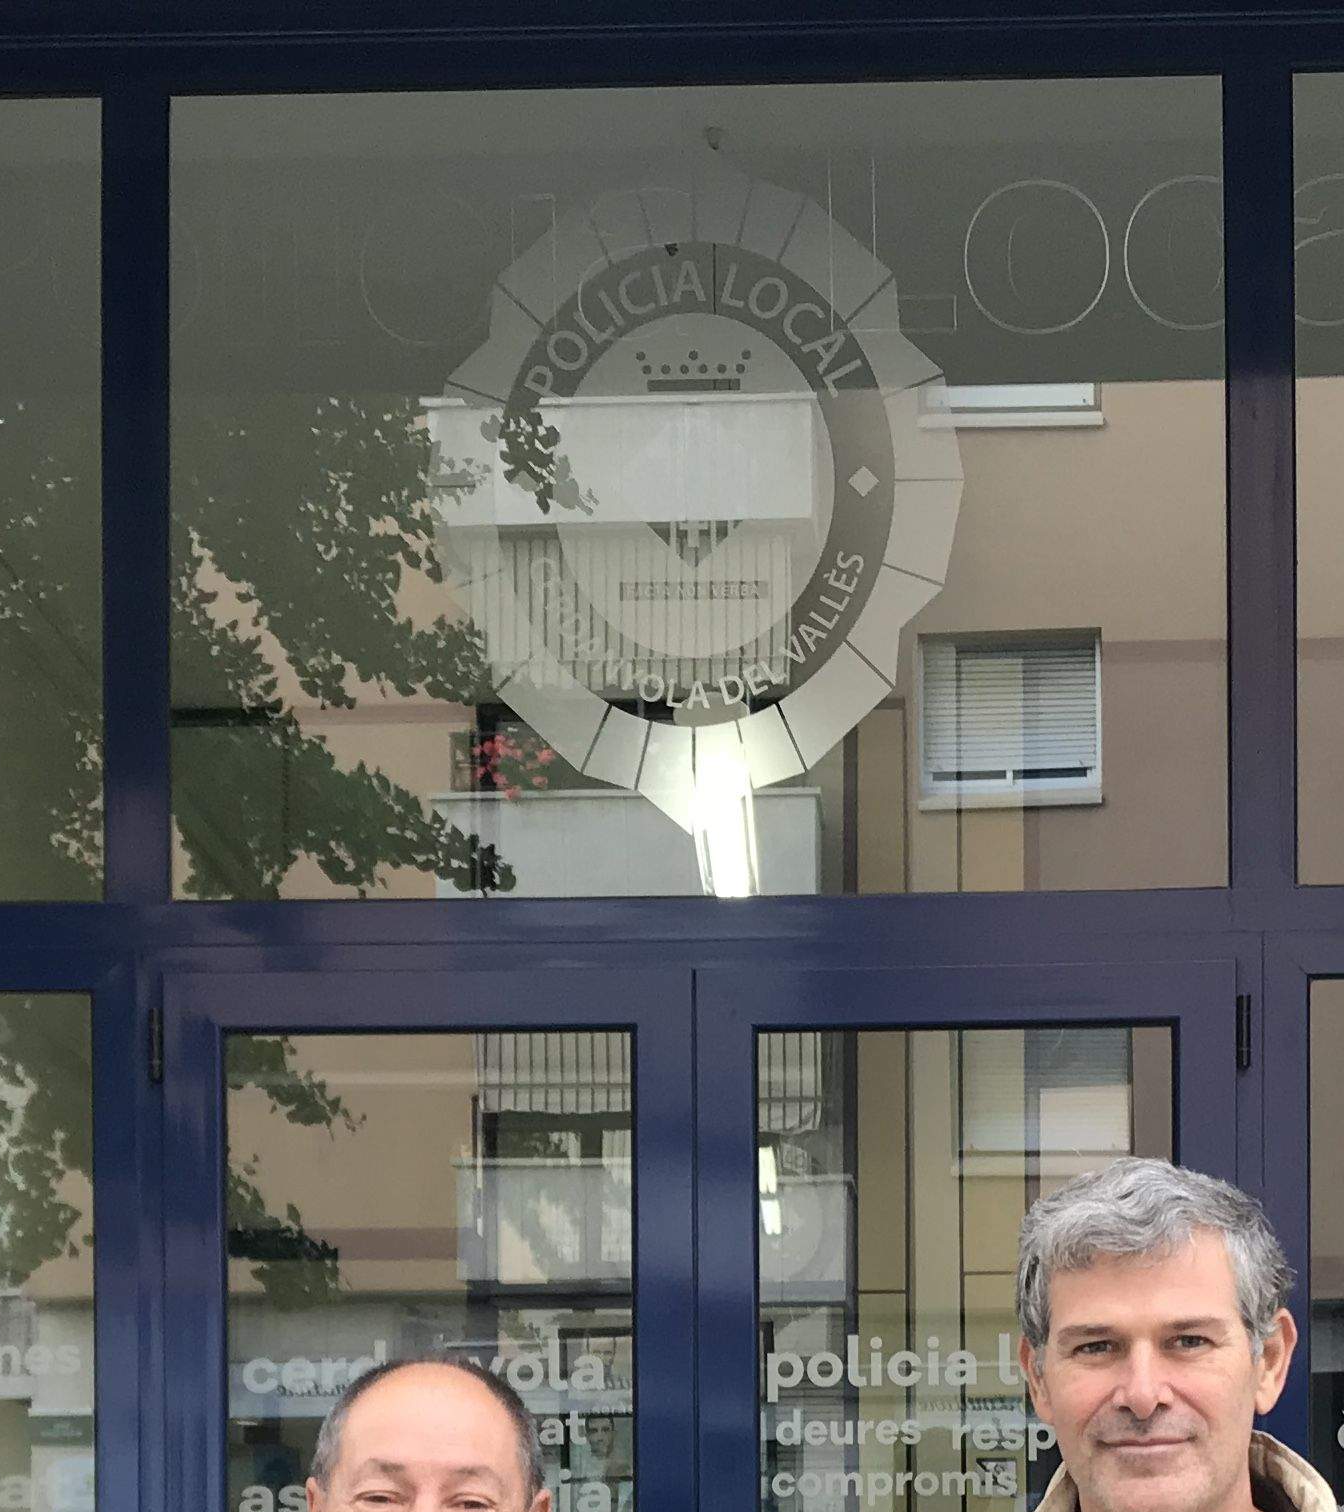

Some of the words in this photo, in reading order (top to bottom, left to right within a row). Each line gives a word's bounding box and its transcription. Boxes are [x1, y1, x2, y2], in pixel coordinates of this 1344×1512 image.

[523, 260, 706, 402] POLICIA
[720, 262, 862, 399] LOCAL
[781, 550, 865, 665] VALLÈS
[767, 1335, 978, 1403] policia
[775, 1408, 922, 1446] deures
[952, 1421, 1057, 1461] resp
